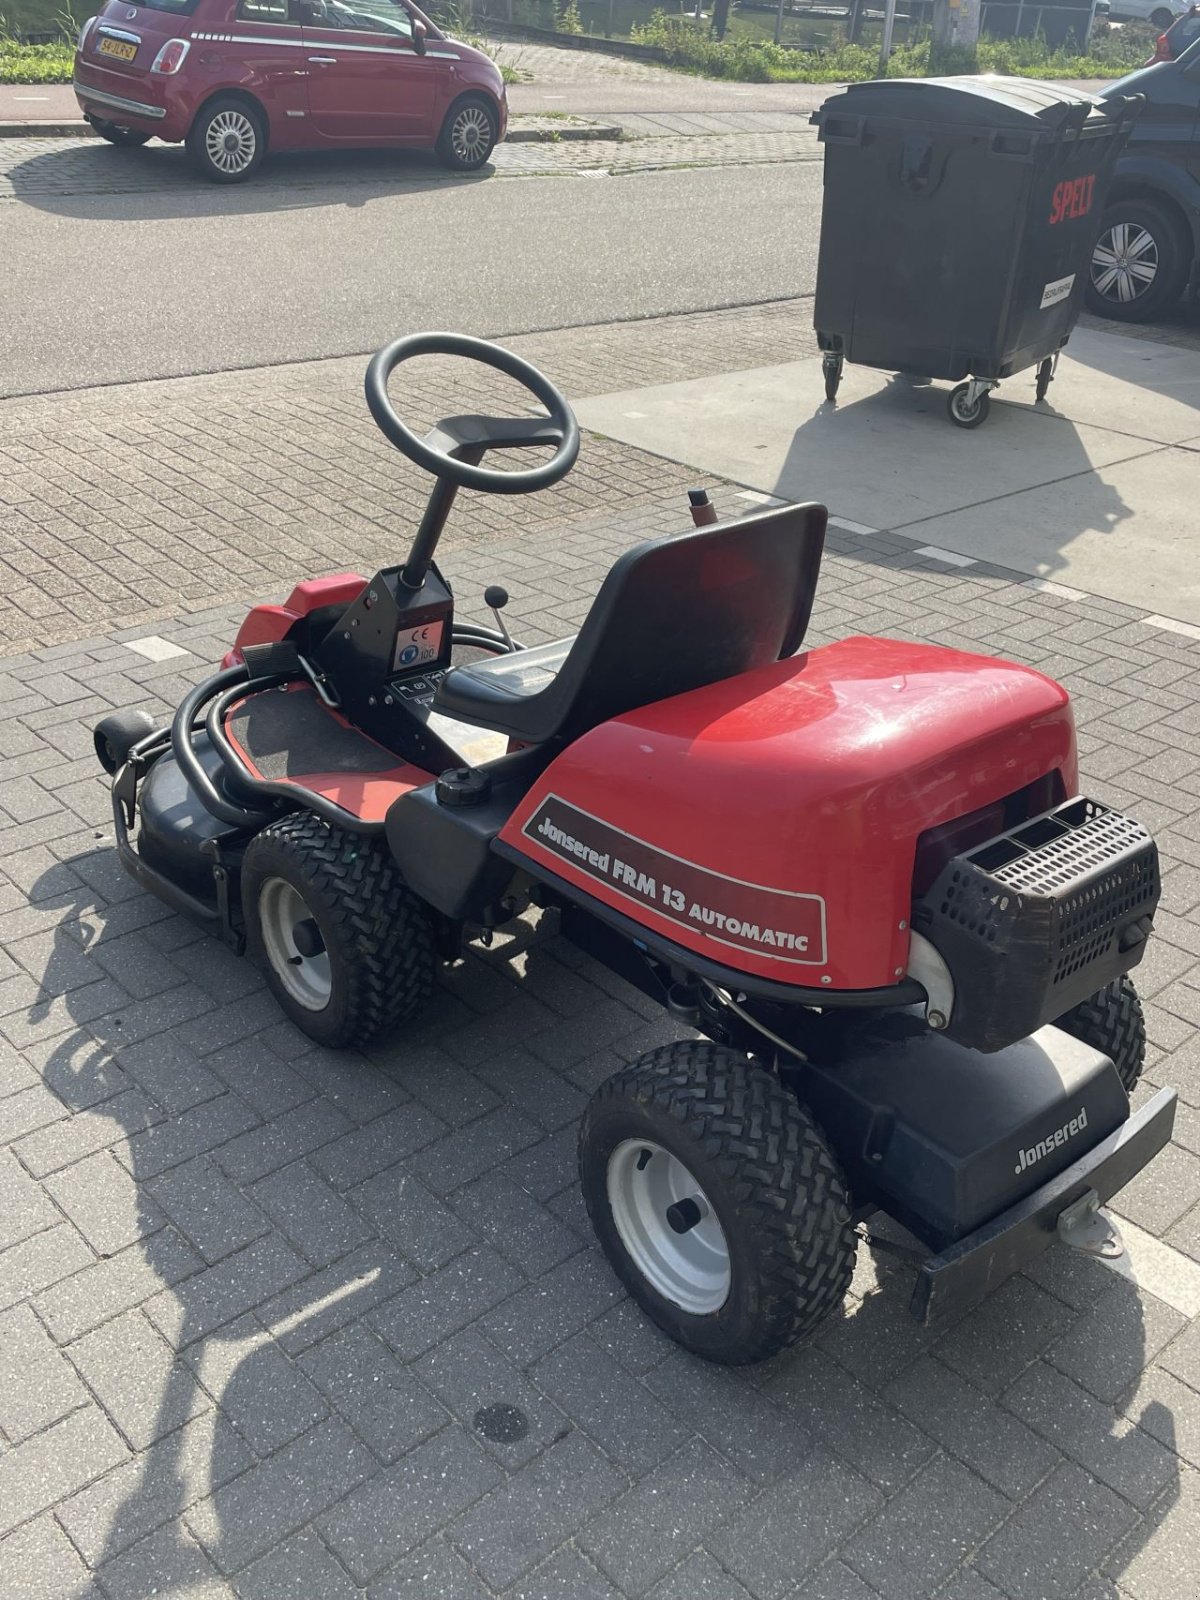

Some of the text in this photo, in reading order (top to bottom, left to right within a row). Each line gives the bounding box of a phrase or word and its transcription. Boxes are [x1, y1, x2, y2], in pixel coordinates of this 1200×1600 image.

[1049, 174, 1095, 224] SPELT
[411, 627, 430, 642] CE
[537, 818, 809, 952] Jonsered FRM 13 AUTOMATIC
[1014, 1106, 1088, 1175] Jonsered
